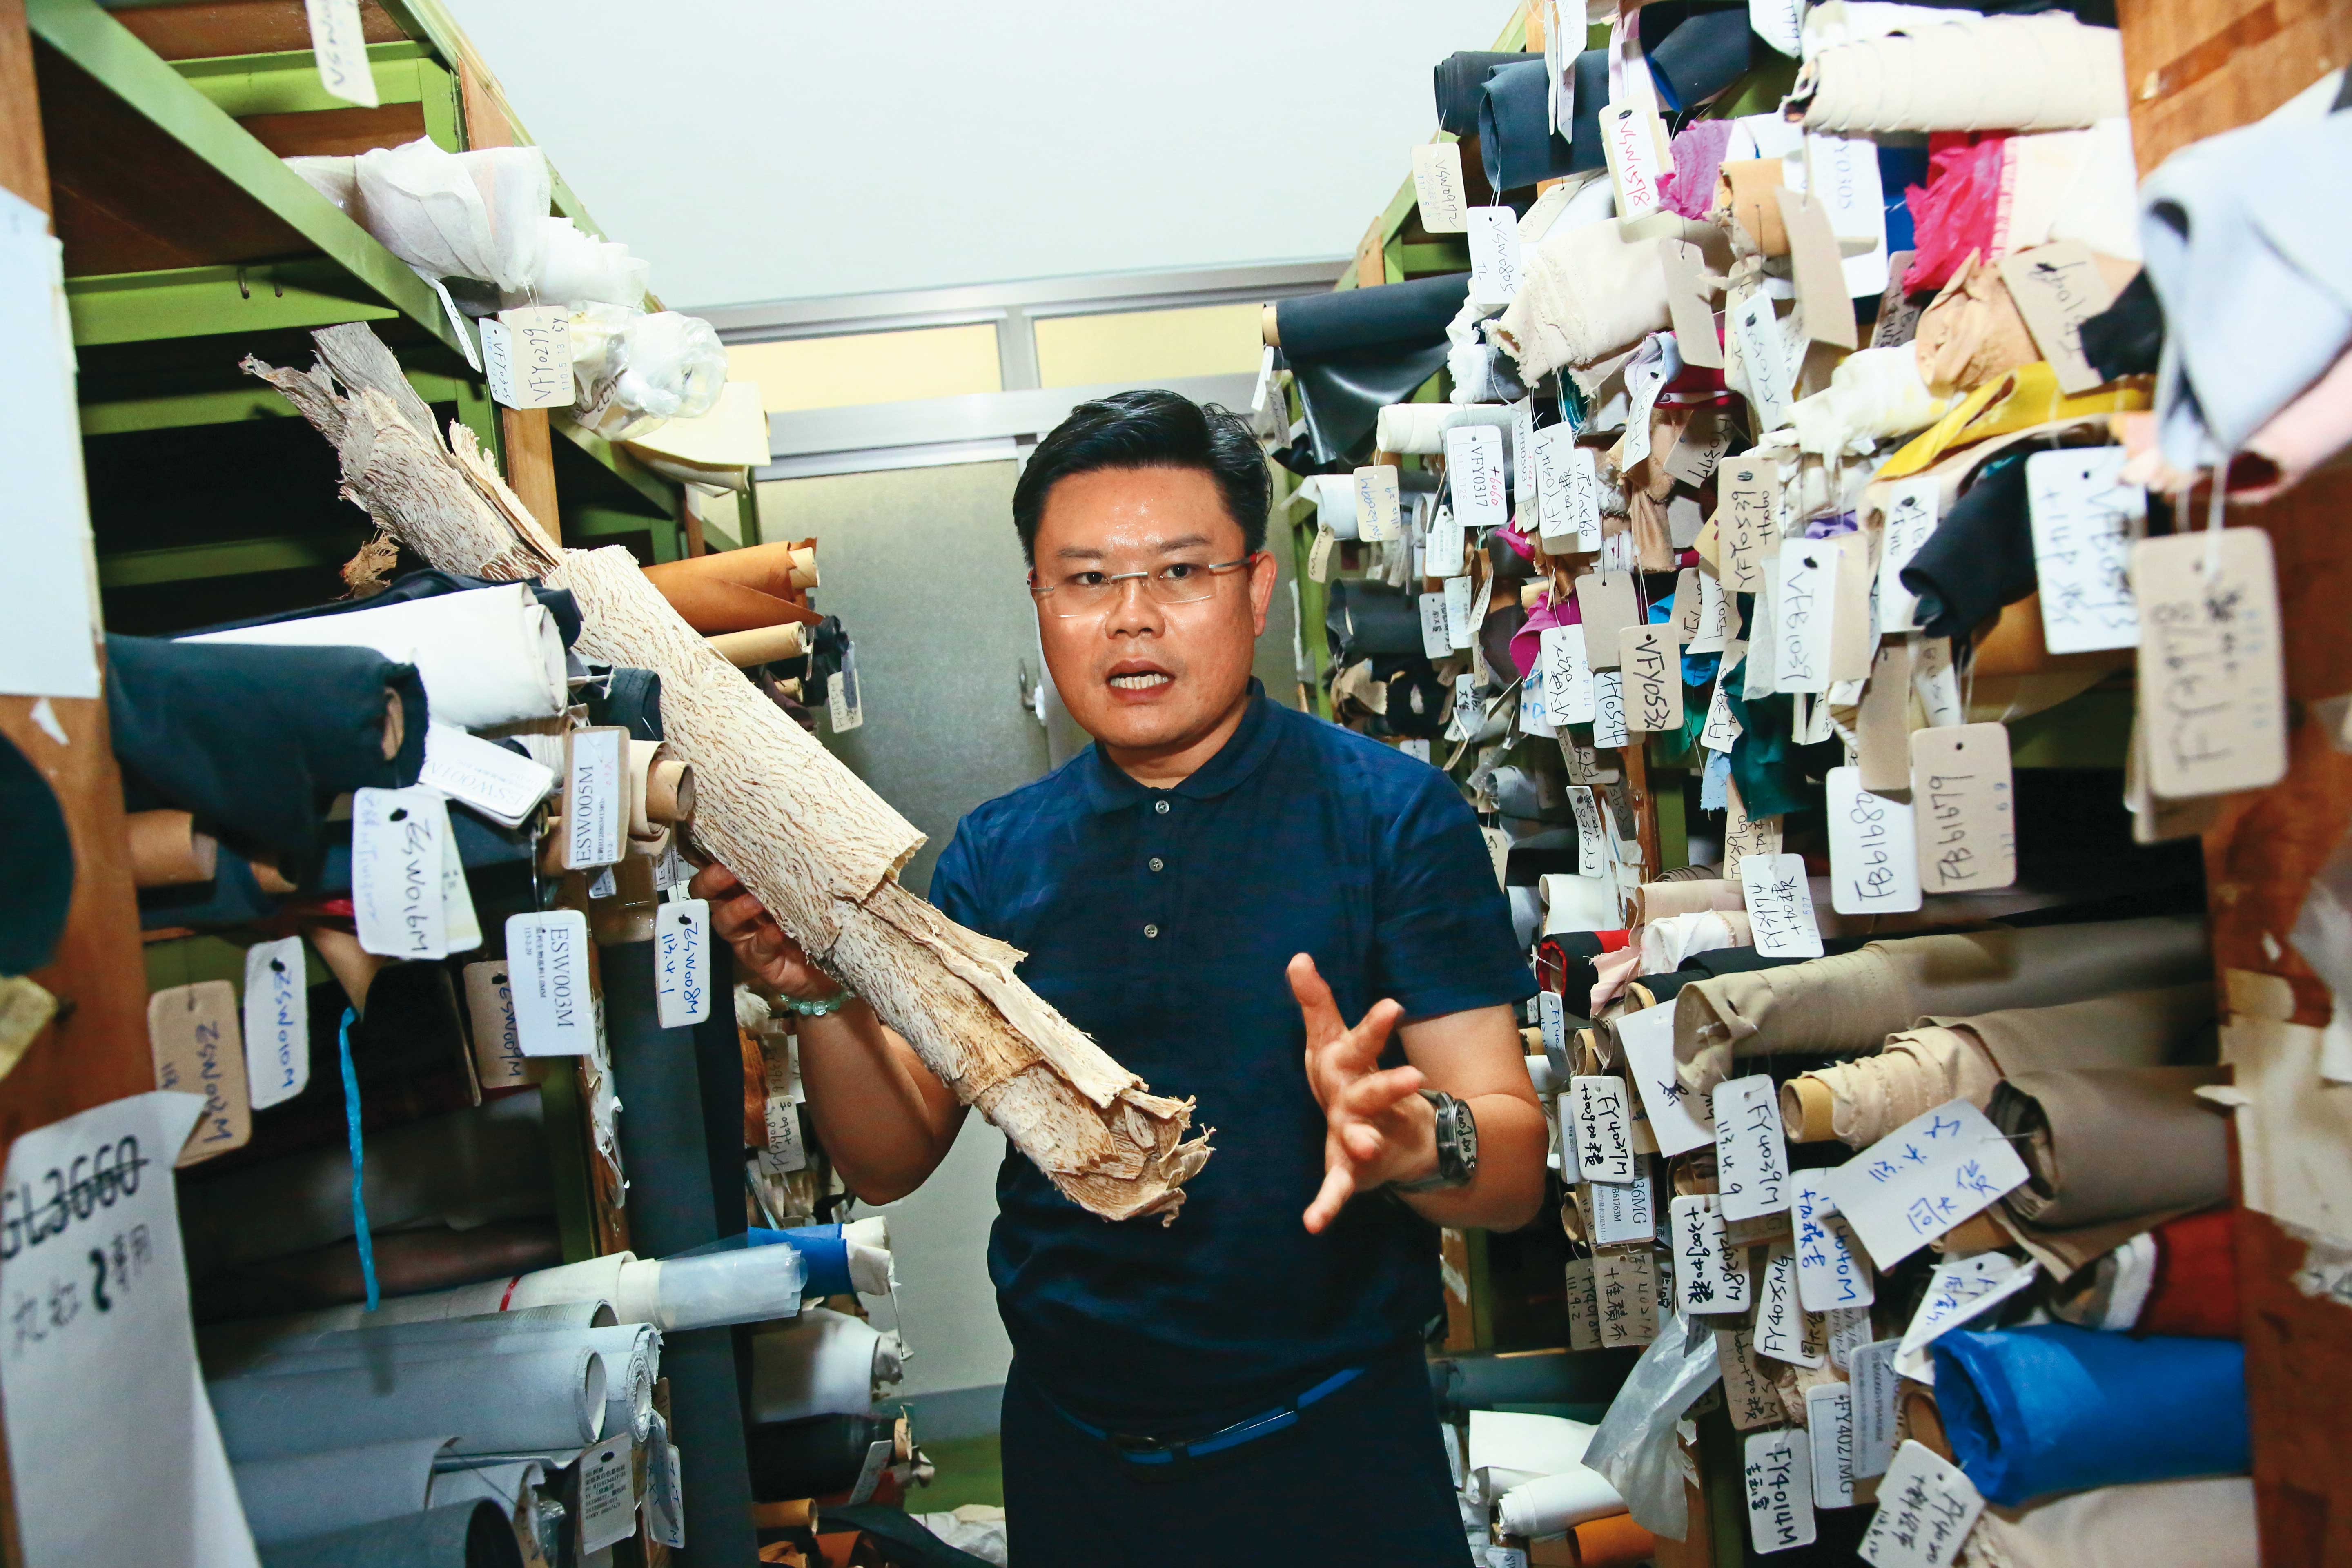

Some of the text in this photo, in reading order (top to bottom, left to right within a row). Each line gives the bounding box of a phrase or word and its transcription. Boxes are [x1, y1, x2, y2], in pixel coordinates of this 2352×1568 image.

[1435, 160, 1458, 229] VSW0972
[1618, 121, 1650, 207] VSW1578
[1491, 221, 1516, 294] VSW0805
[493, 343, 514, 404] VFY0305
[523, 329, 555, 402] VFY0279
[1470, 446, 1488, 506] VFY0317
[1518, 420, 1528, 483] VFB0593
[1535, 443, 1561, 534] VFY0349
[1781, 572, 1814, 681] VFB1039
[1634, 639, 1669, 729] VFY0532
[575, 765, 594, 864] ESW005M
[1929, 775, 1978, 882] FB61679
[1749, 882, 1788, 949] FY3974
[550, 927, 574, 1027] ESW003M
[1597, 1092, 1628, 1174] FY4037M
[1747, 1100, 1782, 1206] FY4039M
[1766, 1447, 1798, 1545] FY4014M
